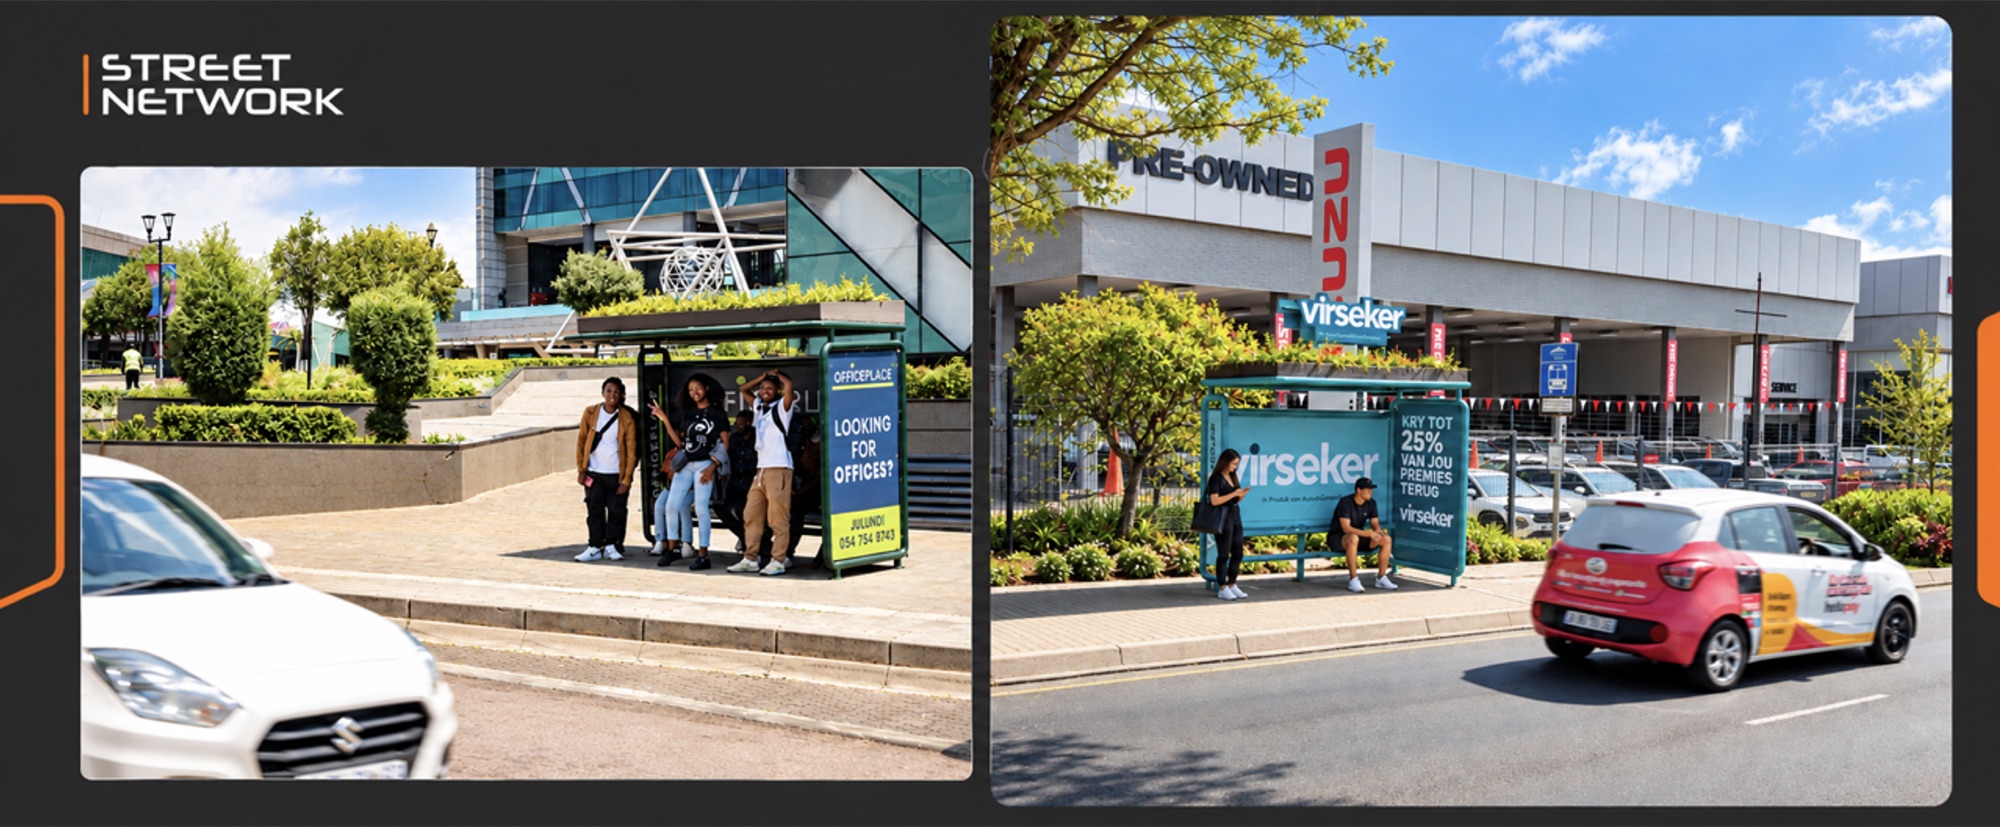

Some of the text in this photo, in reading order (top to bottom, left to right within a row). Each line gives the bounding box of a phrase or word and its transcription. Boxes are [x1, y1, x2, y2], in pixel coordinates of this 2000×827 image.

[1107, 138, 1314, 202] PRE-OWNED
[1321, 146, 1350, 303] UZU
[1301, 294, 1404, 331] virseker
[834, 368, 893, 384] OFFICEPLACE
[1771, 381, 1798, 394] SERVICE
[834, 415, 892, 438] LOOKING
[1401, 415, 1454, 430] KRY TOT
[851, 439, 877, 460] FOR
[1401, 429, 1444, 454] 25%
[834, 459, 894, 485] OFFICES?
[1400, 453, 1453, 470] VAN JOU
[1400, 467, 1454, 485] PREMIES
[1400, 482, 1440, 498] TERUG
[1399, 503, 1454, 528] virseker
